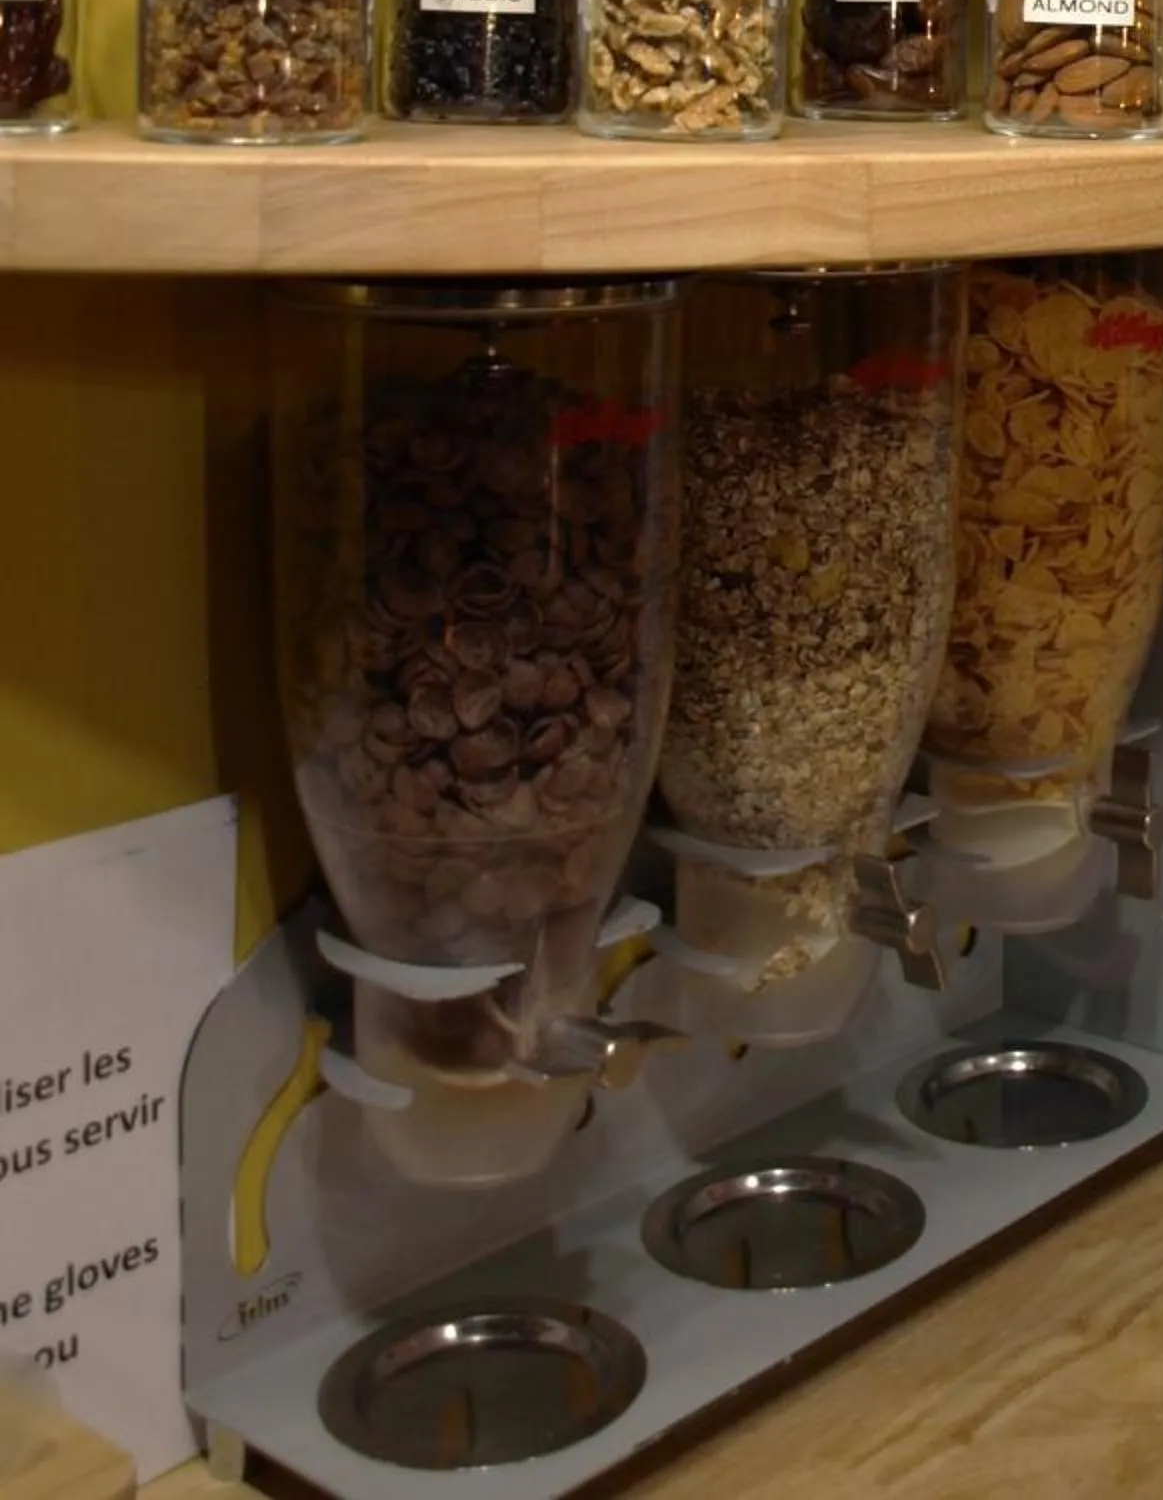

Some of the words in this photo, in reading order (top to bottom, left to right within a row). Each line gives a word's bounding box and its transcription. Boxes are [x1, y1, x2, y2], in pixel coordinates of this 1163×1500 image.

[0, 1062, 72, 1116] iser
[83, 1046, 132, 1086] les
[64, 1093, 166, 1156] servir
[43, 1237, 160, 1315] gloves
[34, 1334, 79, 1370] ou
